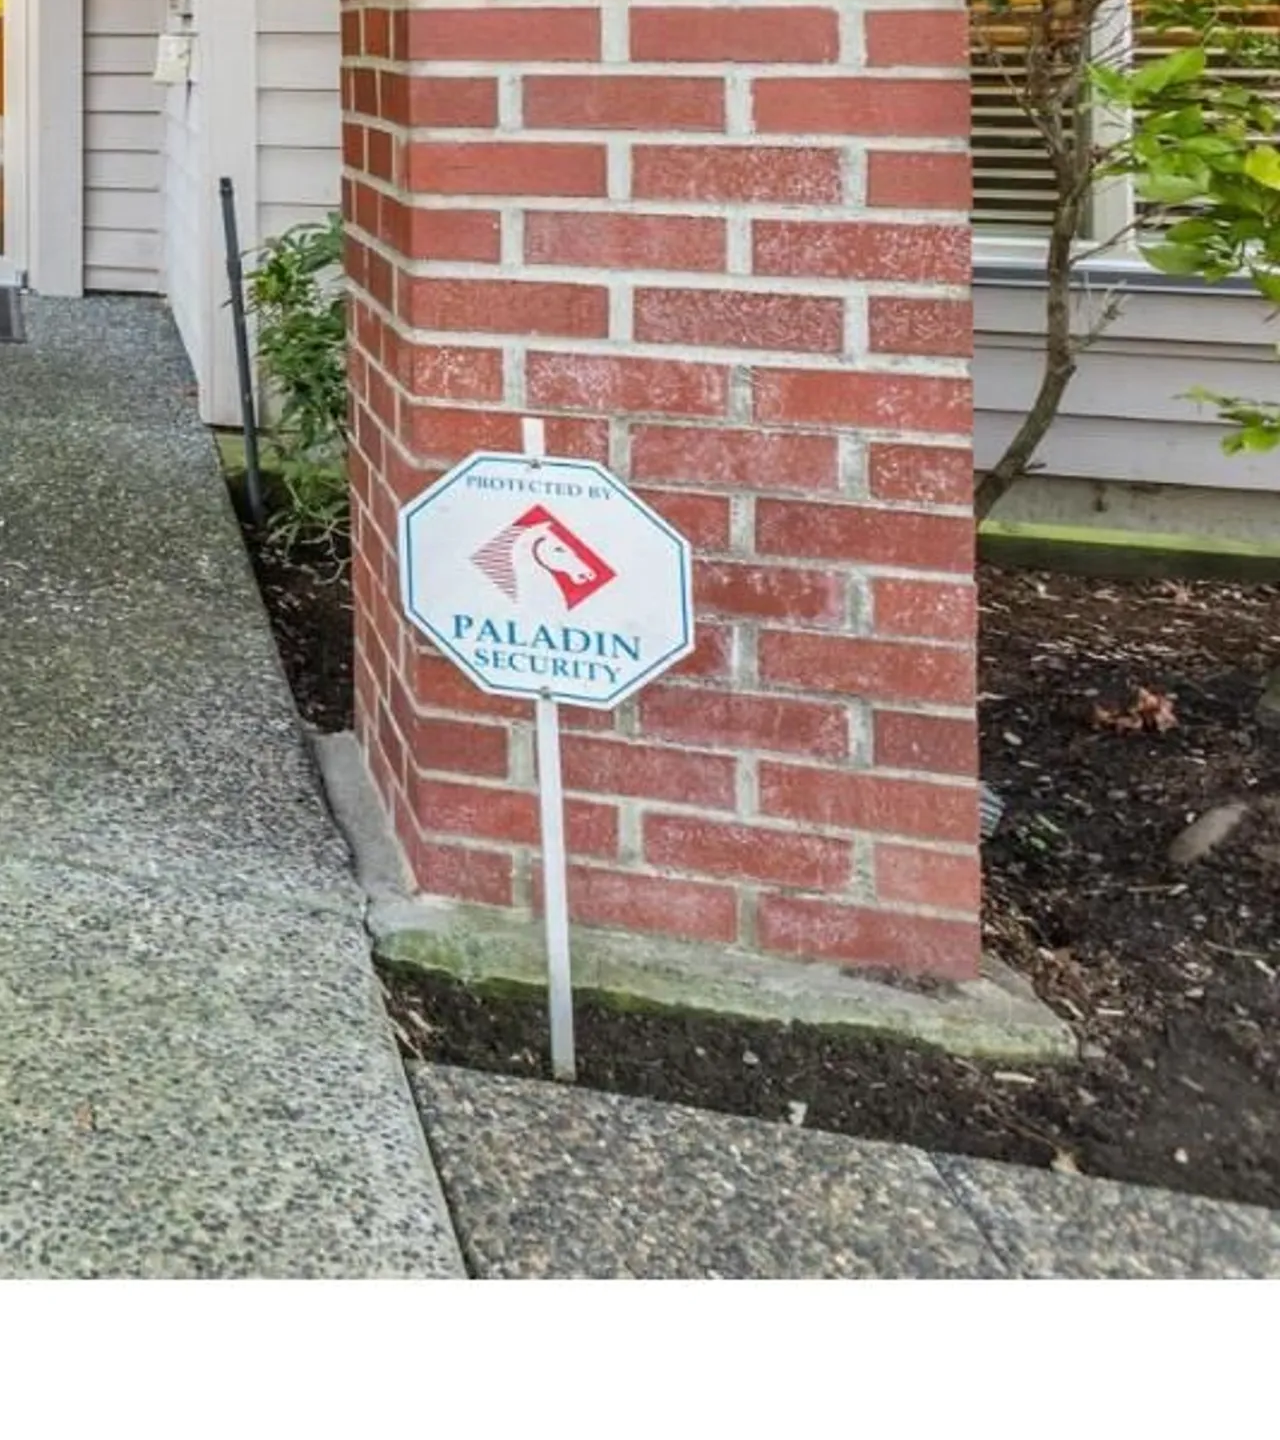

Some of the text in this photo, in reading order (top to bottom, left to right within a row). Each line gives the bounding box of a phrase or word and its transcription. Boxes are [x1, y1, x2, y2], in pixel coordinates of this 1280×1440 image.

[465, 474, 613, 501] PROTECTED BY
[452, 614, 641, 660] PALADIN
[474, 647, 621, 683] SECURITY
